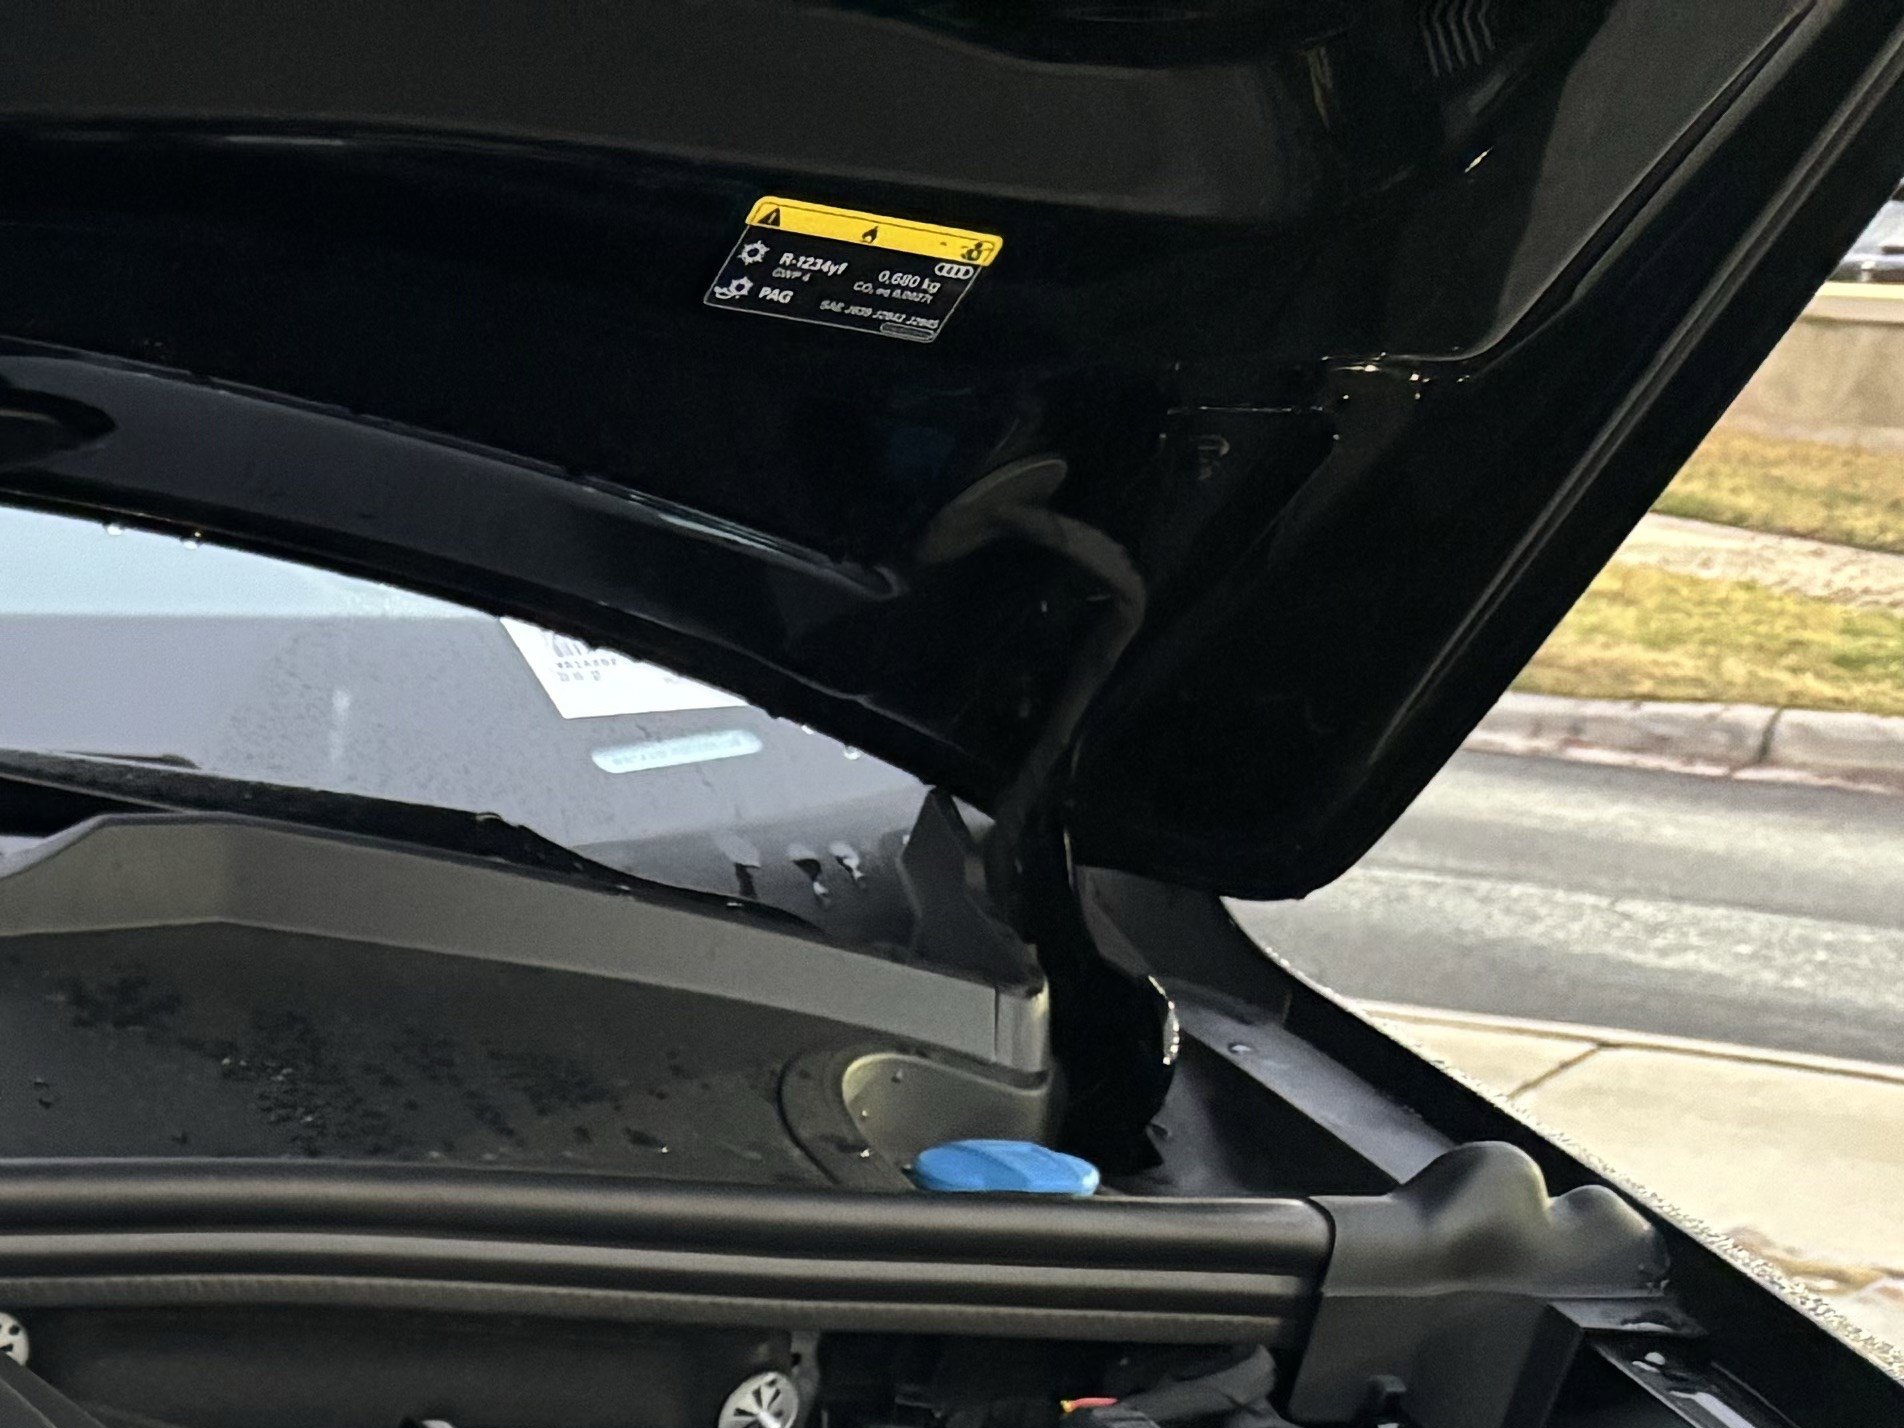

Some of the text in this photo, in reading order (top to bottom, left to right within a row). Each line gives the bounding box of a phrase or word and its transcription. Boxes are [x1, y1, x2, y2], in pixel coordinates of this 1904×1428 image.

[779, 253, 848, 276] R-1234yf
[921, 277, 941, 294] kg
[758, 286, 794, 304] PAG
[819, 300, 845, 312] SAE
